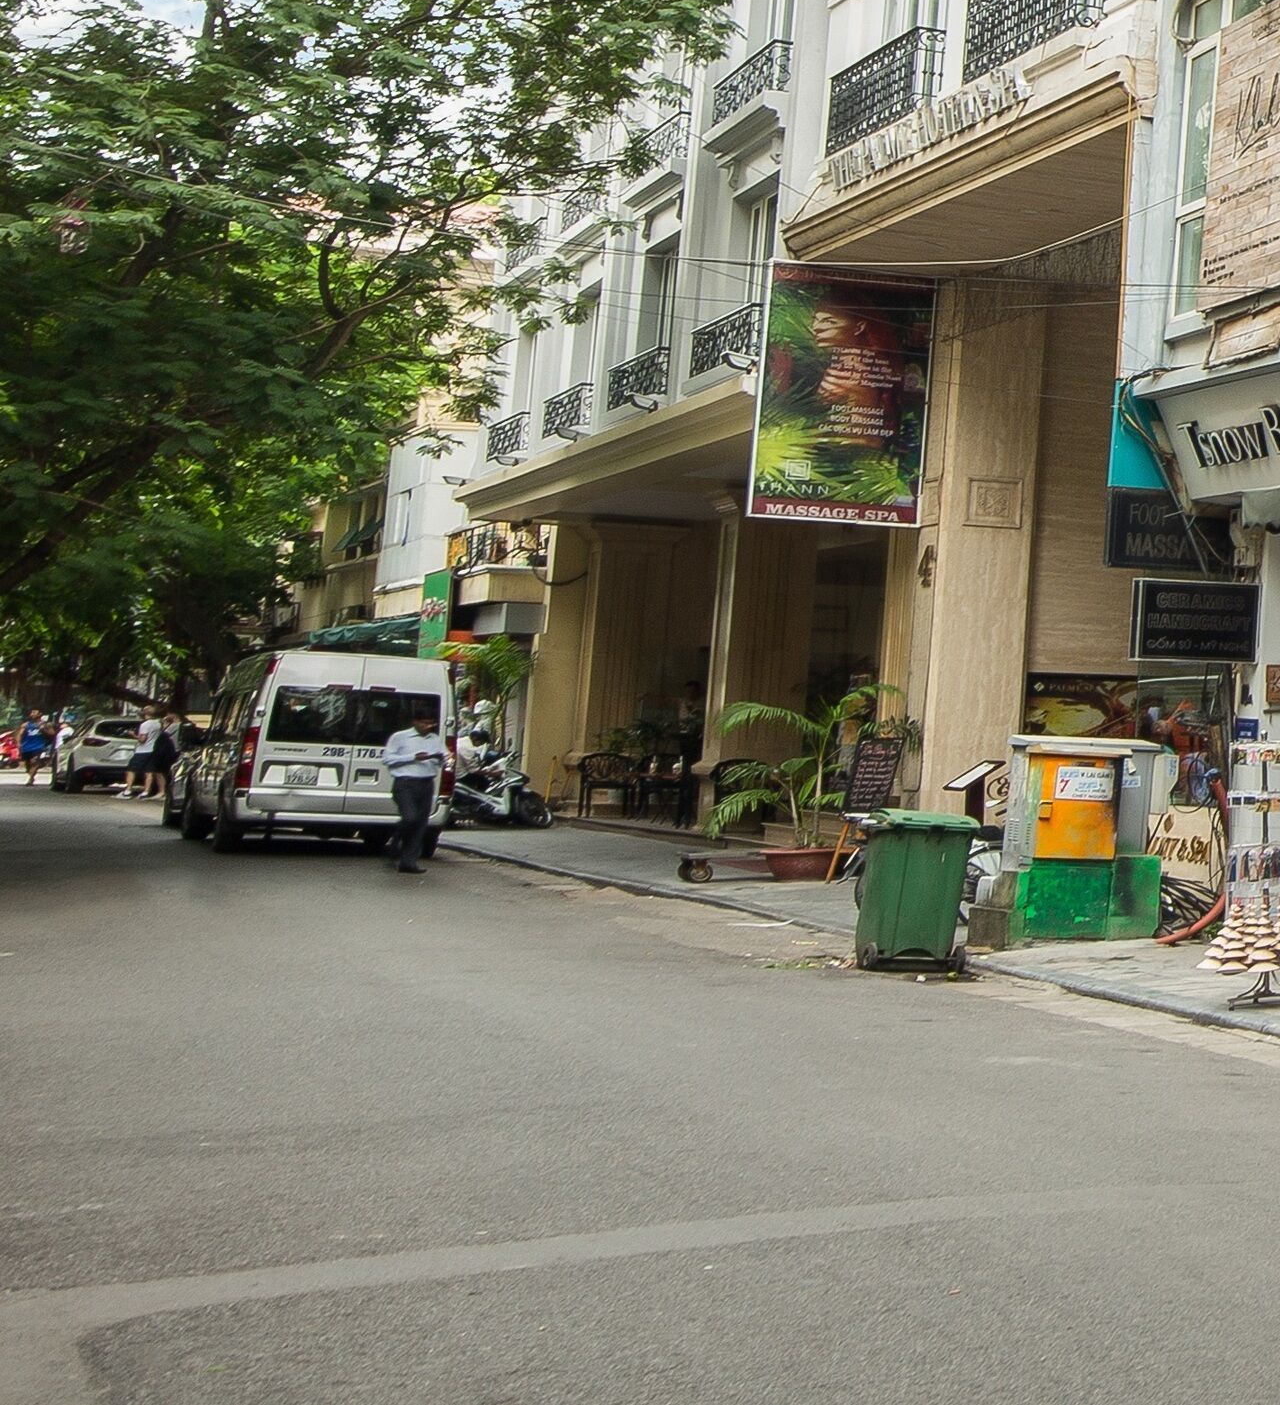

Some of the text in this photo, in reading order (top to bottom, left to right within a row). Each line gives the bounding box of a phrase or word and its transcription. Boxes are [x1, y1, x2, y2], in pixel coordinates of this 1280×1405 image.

[765, 503, 900, 522] MASSAGE SPA
[1130, 503, 1171, 526] FOOT
[1126, 532, 1195, 560] MASSA
[1156, 591, 1246, 612] CERAMICS
[1147, 612, 1252, 633] HANDICRAFT
